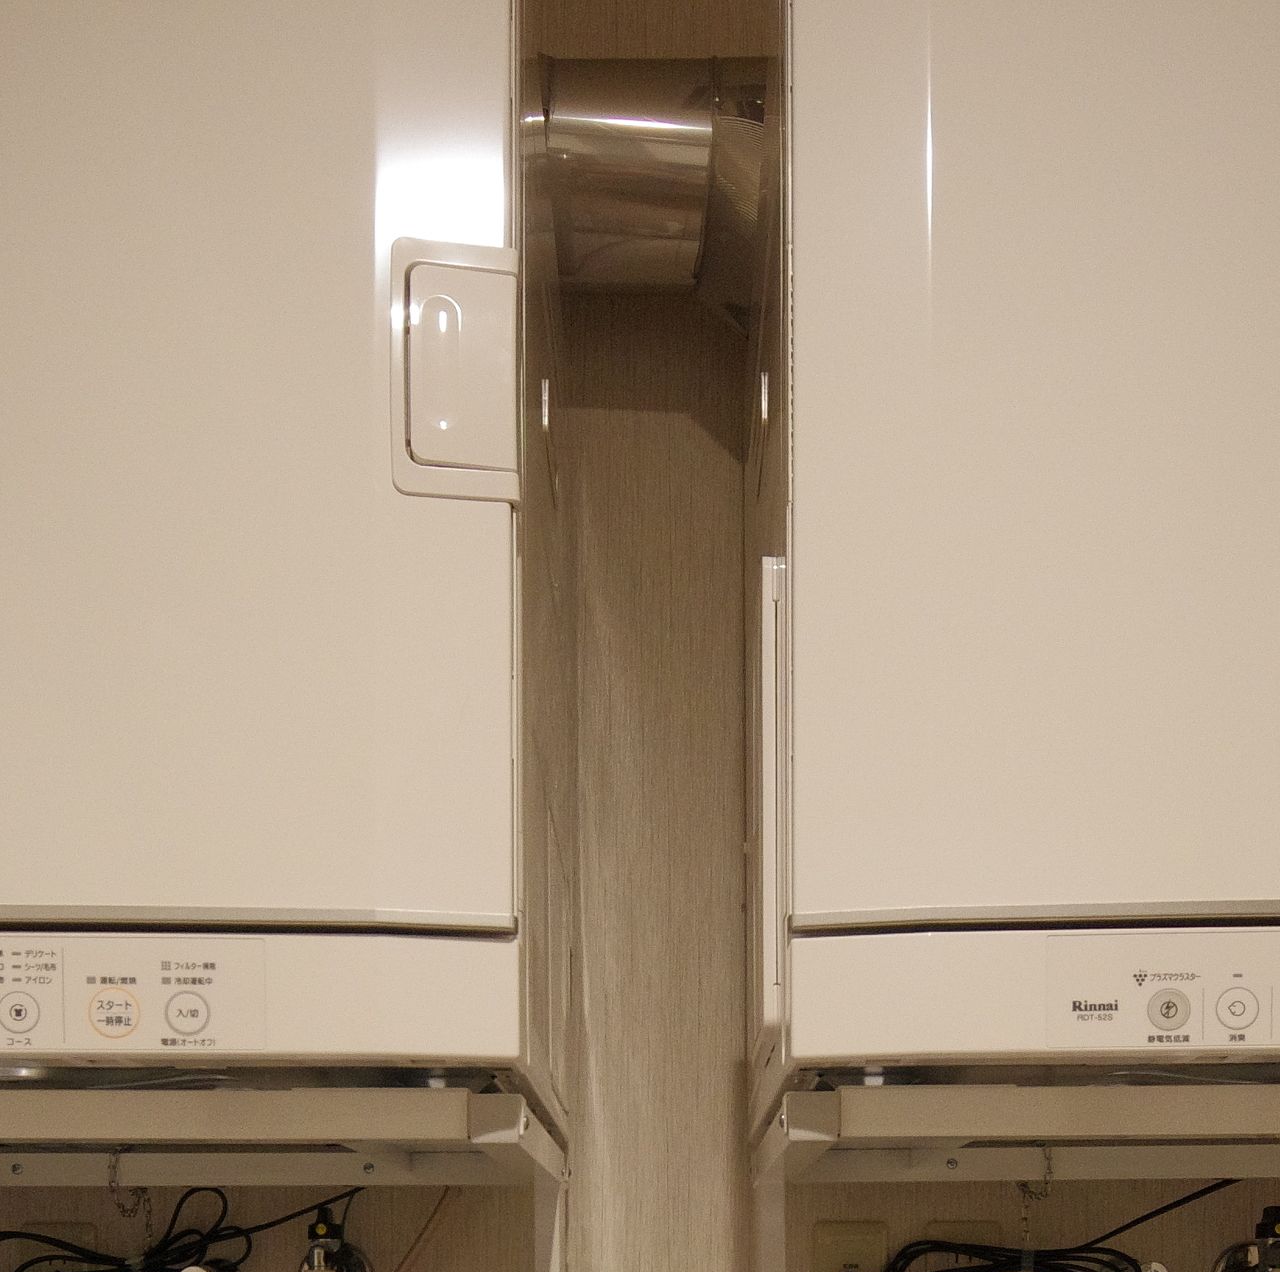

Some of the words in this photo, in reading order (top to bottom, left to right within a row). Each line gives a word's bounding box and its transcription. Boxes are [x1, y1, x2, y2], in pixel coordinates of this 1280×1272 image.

[24, 950, 57, 958] デリケート
[24, 963, 57, 971] シーツ/毛布
[24, 976, 53, 985] アイロン
[1149, 972, 1201, 982] プラズマクラスター
[96, 1001, 132, 1011] スタート
[1071, 999, 1119, 1013] Rinnai
[175, 1009, 199, 1019] 入/切
[1077, 1013, 1114, 1022] RDT-52S
[96, 1016, 132, 1027] 一時停止
[6, 1037, 32, 1046] コース
